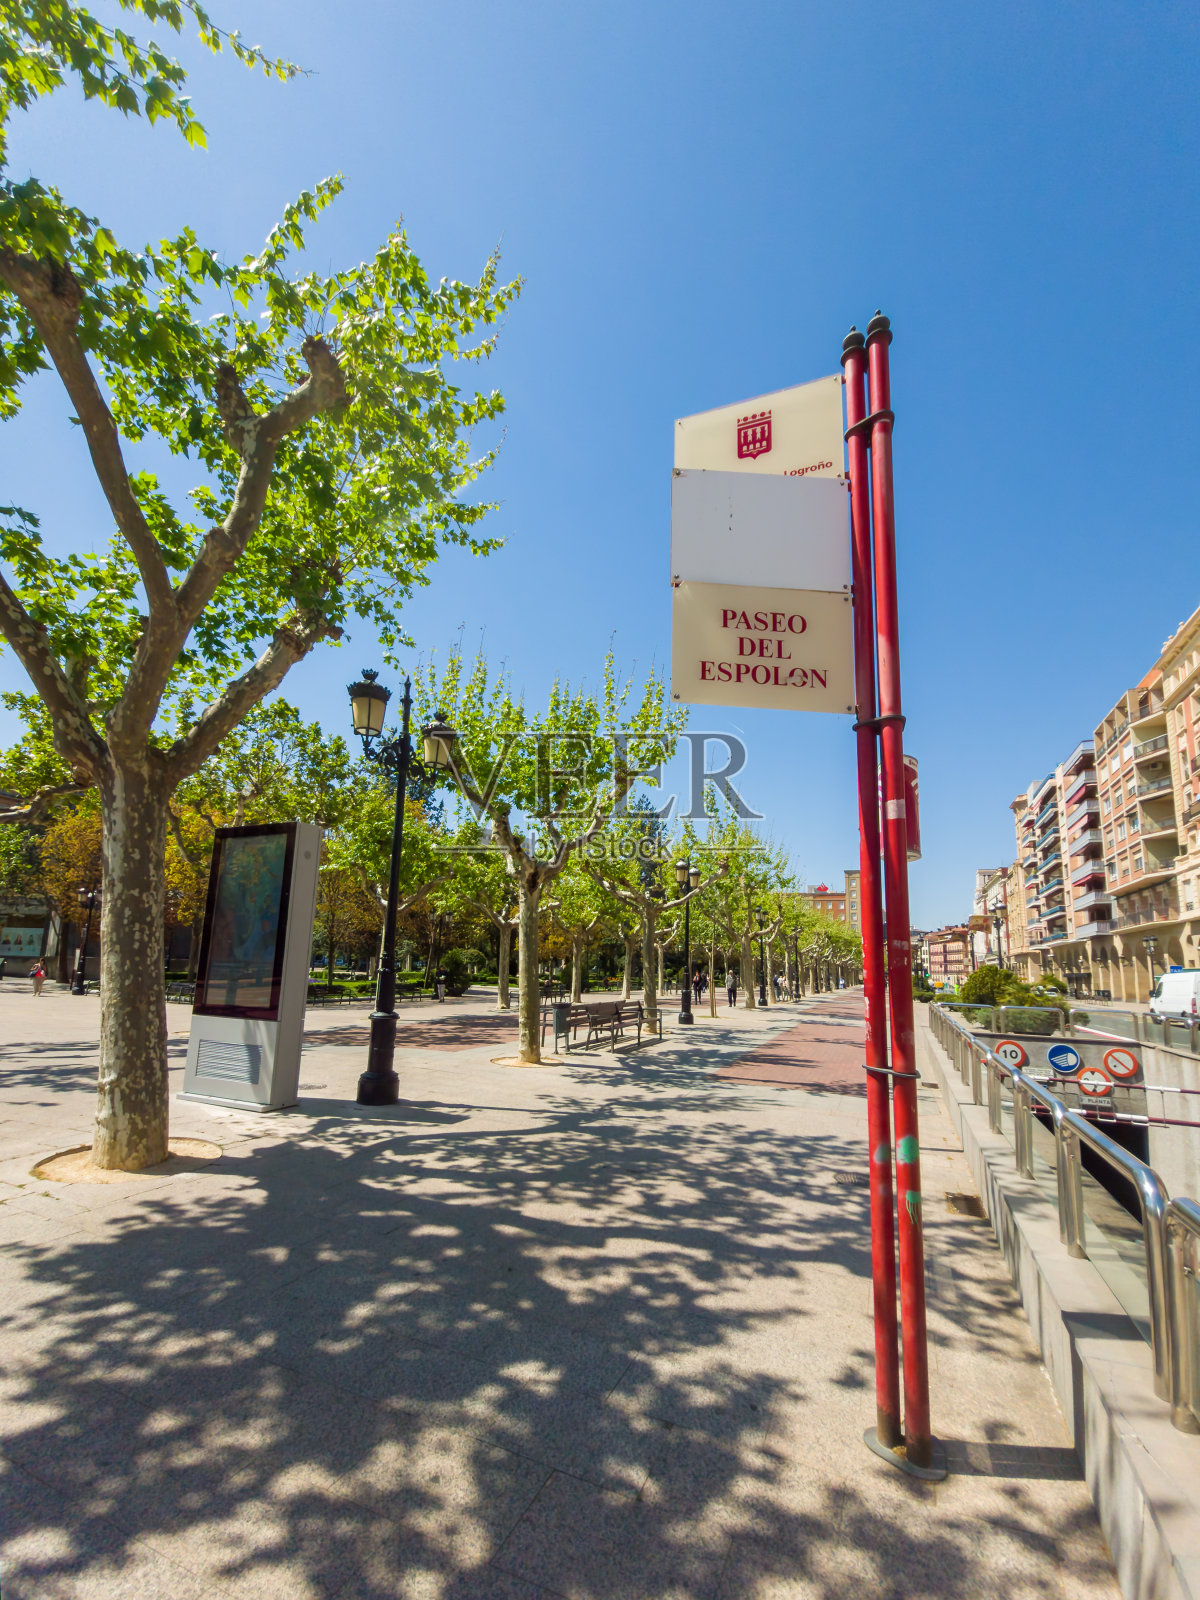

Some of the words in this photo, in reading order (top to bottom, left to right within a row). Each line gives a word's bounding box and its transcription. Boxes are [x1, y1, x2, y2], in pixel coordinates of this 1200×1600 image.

[720, 608, 808, 634] PASEO
[737, 636, 792, 660] DEL
[699, 660, 829, 689] ESPOLON
[1003, 1049, 1019, 1060] 10
